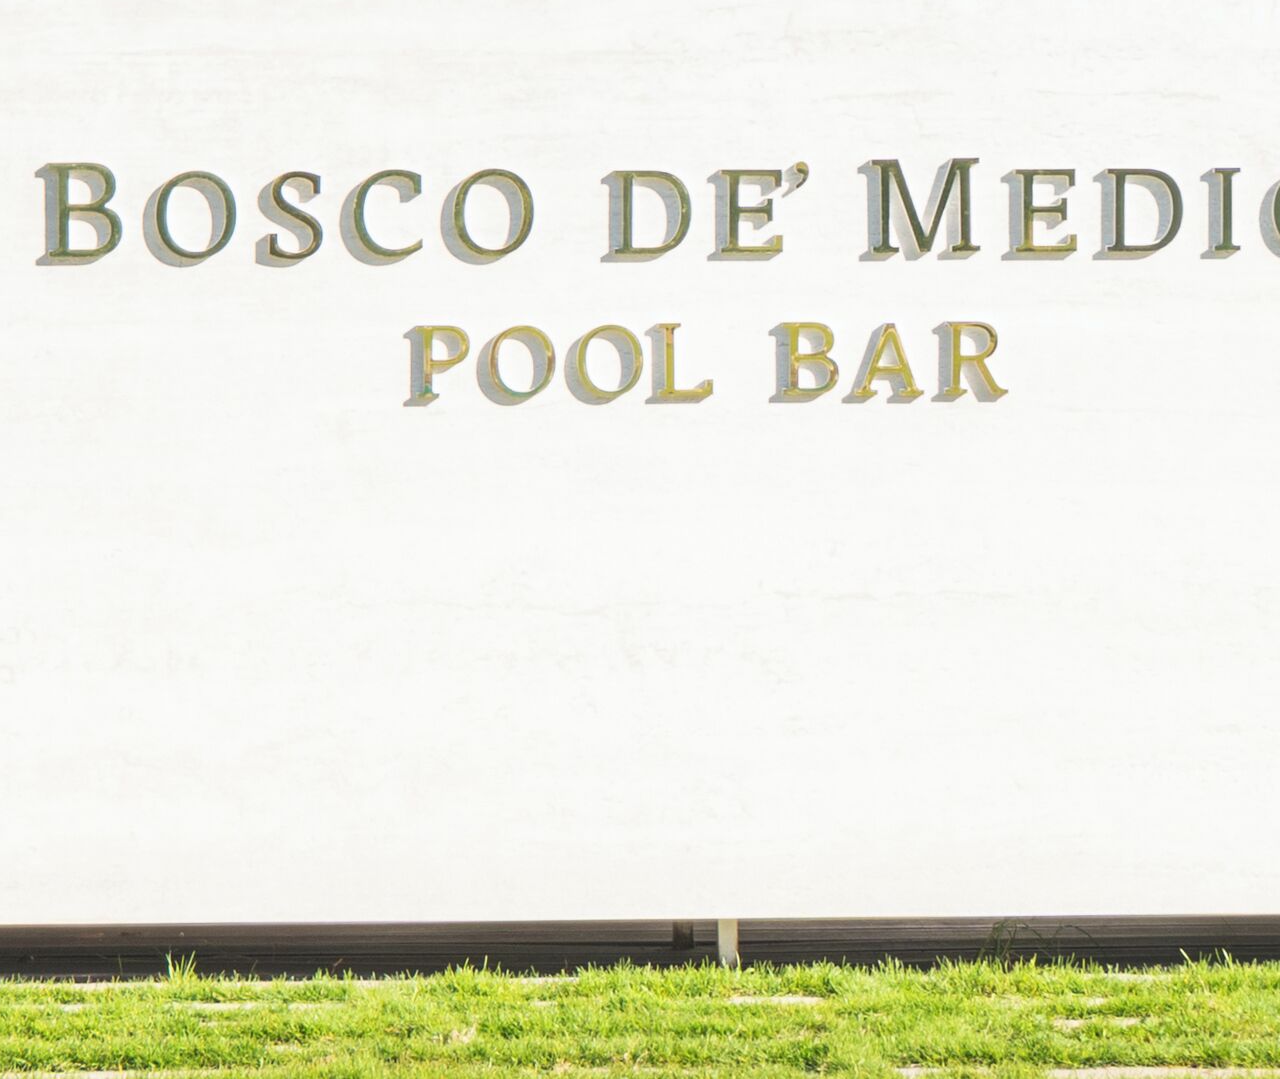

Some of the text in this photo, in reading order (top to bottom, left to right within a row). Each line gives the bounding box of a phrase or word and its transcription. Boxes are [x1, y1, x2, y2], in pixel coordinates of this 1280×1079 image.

[35, 162, 536, 268] BOSCO
[403, 321, 1009, 407] POOL BAR
